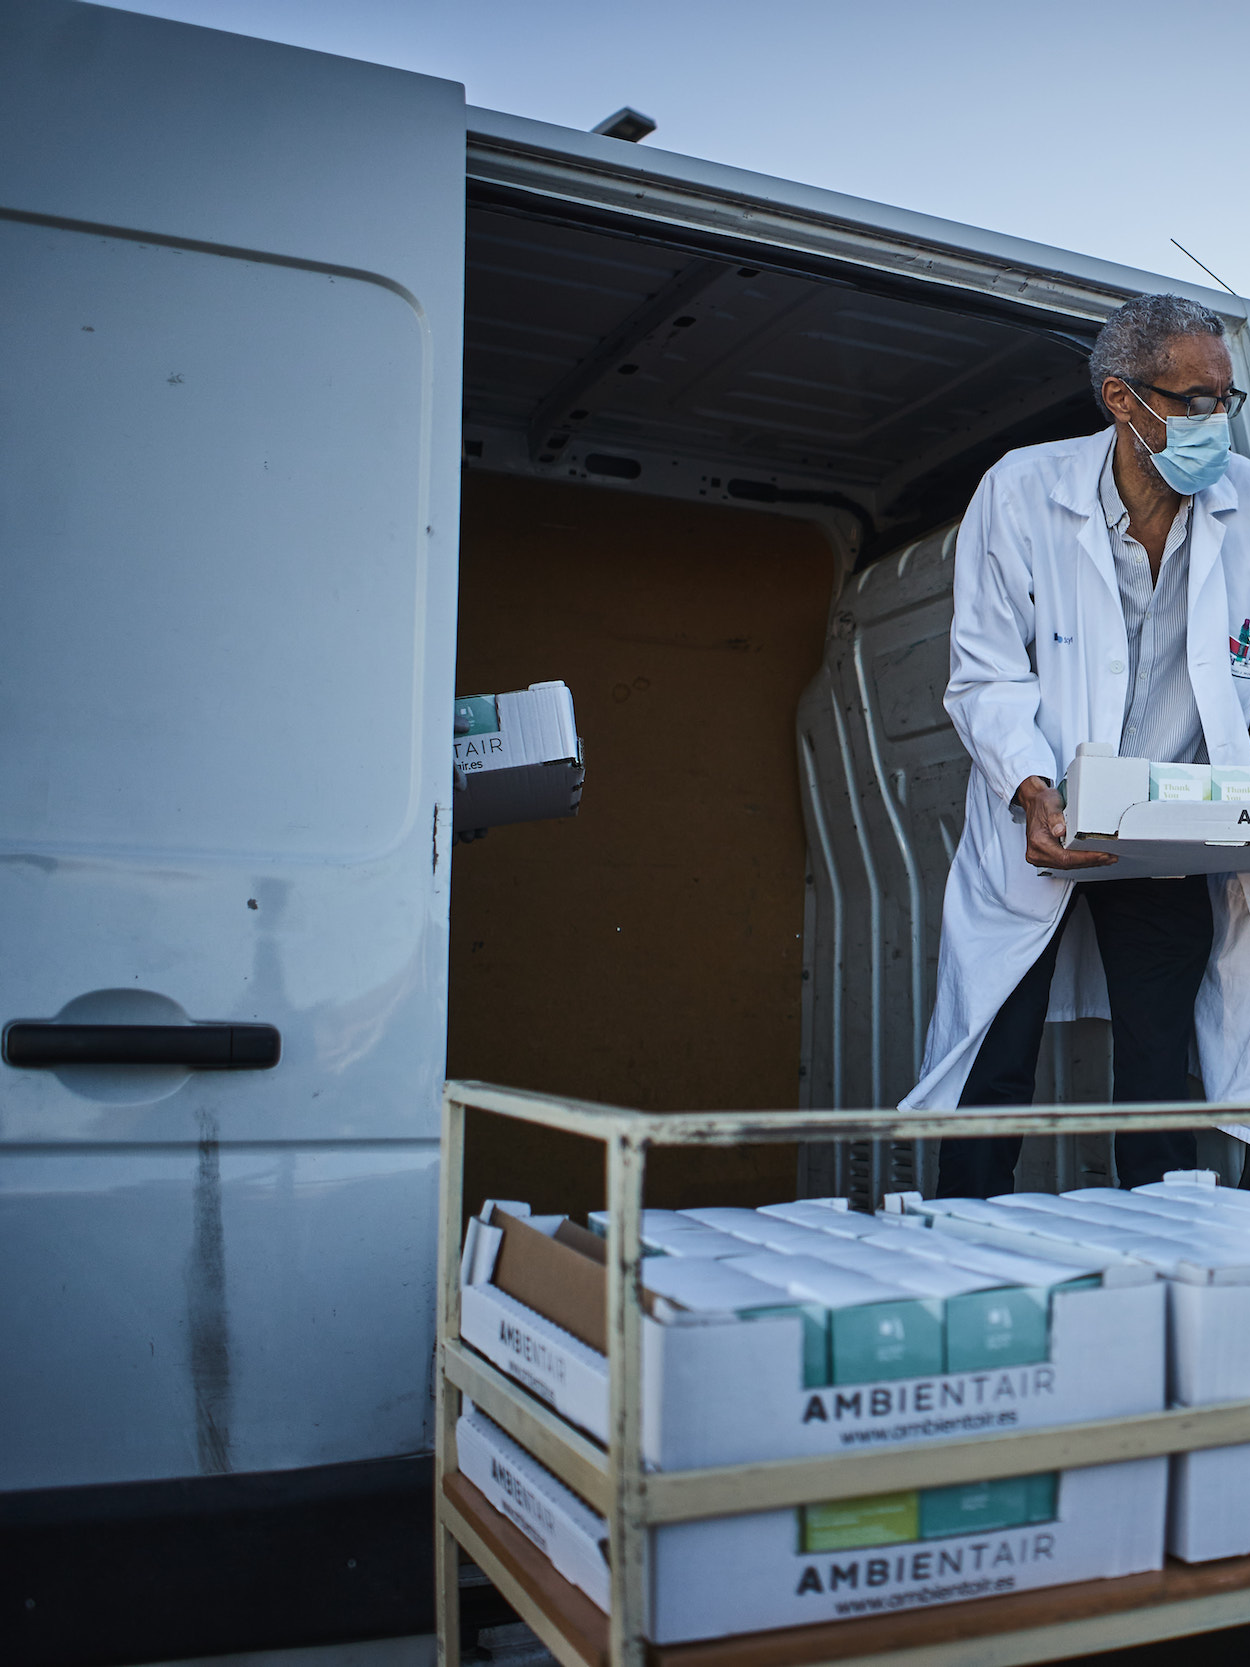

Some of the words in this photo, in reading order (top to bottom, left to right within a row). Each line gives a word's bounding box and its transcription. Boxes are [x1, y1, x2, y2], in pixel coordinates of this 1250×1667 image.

[1163, 783, 1190, 792] Thank
[802, 1368, 1056, 1425] AMBIENTAIR
[840, 1408, 1018, 1446] www.ambientair.es
[796, 1533, 1056, 1597] AMBIENTAIR
[834, 1574, 1017, 1616] www.ambientair.es
